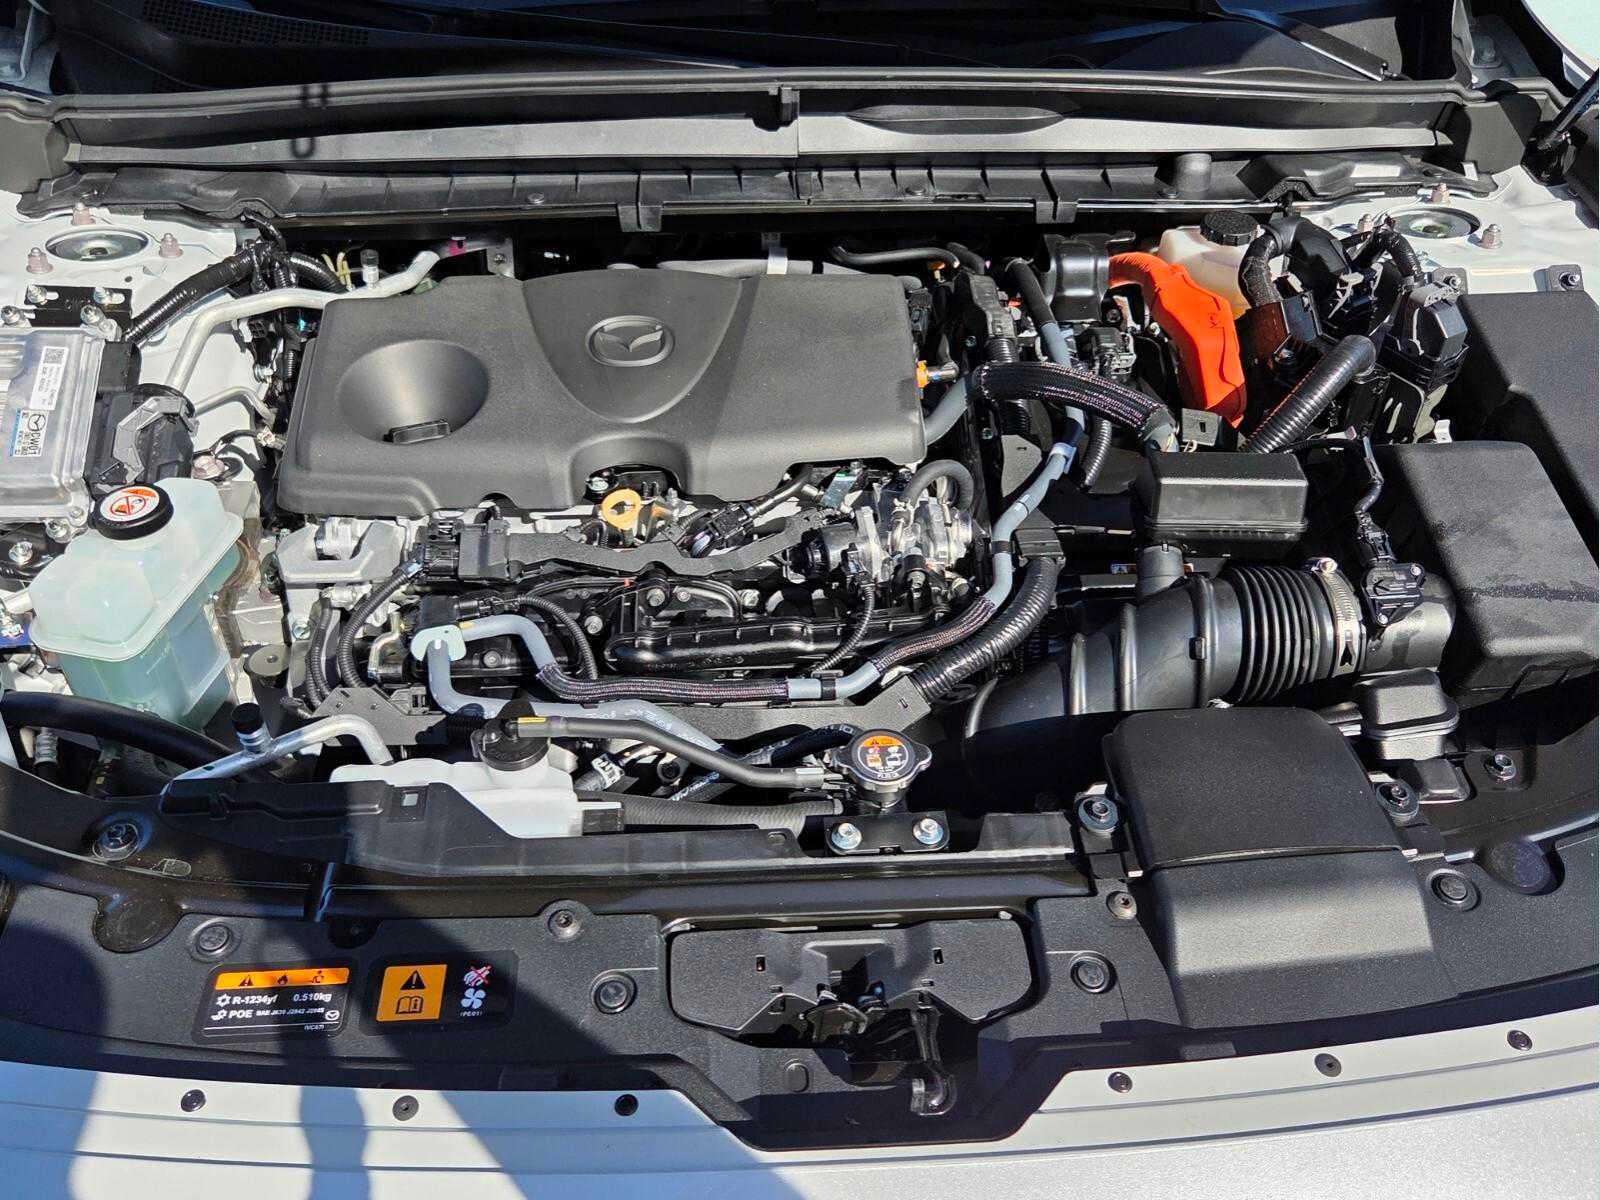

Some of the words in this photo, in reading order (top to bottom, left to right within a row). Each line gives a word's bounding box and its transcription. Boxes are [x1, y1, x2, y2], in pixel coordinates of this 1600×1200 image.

[231, 994, 278, 1005] R-1234yf
[293, 992, 332, 1003] 0.510kg
[228, 1009, 253, 1019] POE
